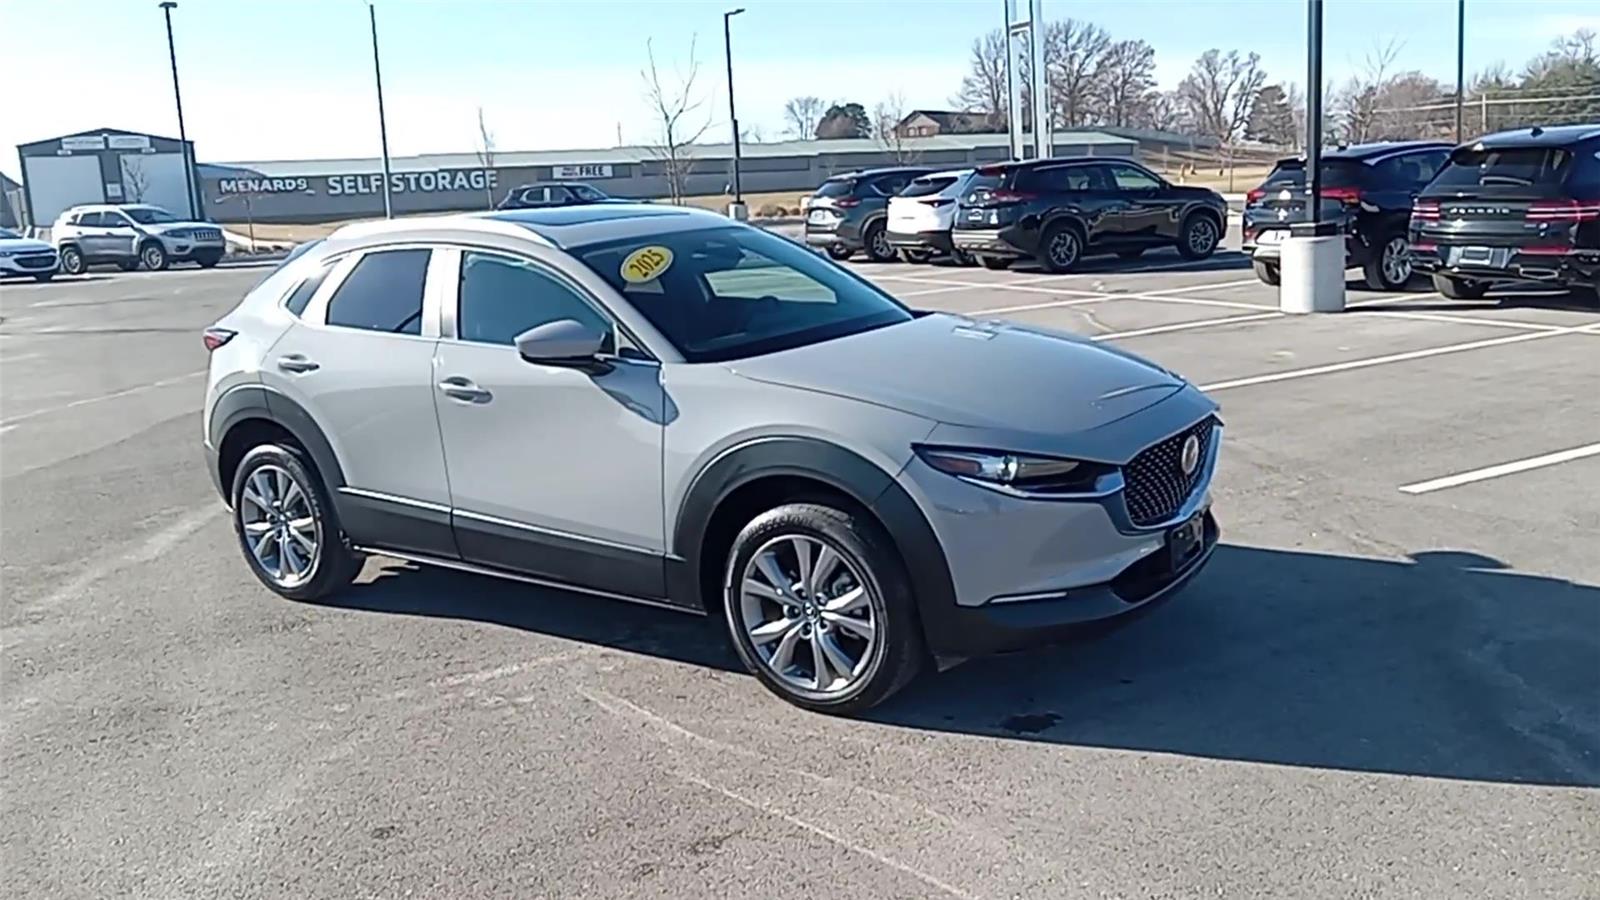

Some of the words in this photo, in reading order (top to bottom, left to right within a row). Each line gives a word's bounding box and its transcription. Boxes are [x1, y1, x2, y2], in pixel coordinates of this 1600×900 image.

[219, 178, 309, 194] MENARDS
[327, 175, 383, 195] SELF
[390, 169, 498, 193] STORAGE
[579, 165, 605, 177] FREE
[628, 249, 665, 278] 2025
